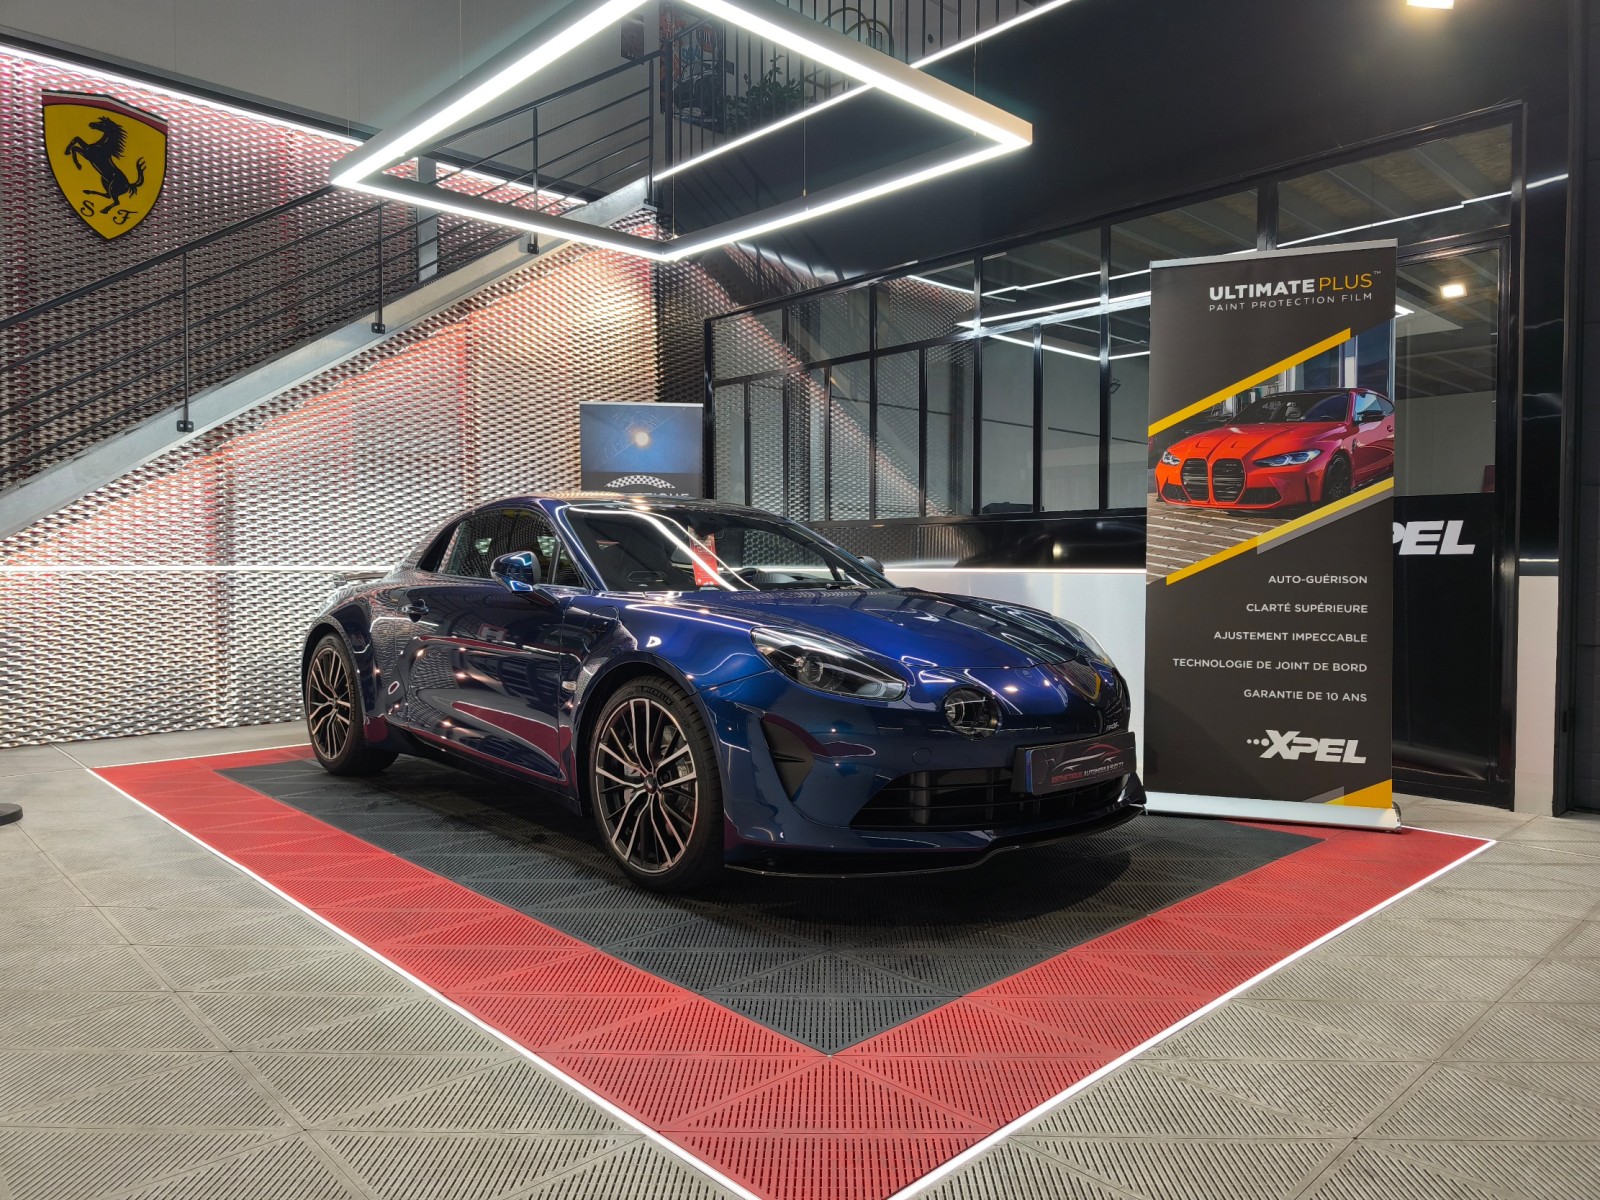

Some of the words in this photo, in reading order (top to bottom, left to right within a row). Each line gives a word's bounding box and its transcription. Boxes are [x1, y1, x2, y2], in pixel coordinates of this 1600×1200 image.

[80, 200, 95, 217] S
[112, 209, 139, 225] F
[1209, 278, 1316, 301] ULTIMATE
[1319, 273, 1373, 292] PLUS
[1209, 302, 1246, 312] PAINT
[1251, 296, 1335, 309] PROTECTION
[1342, 292, 1372, 302] FILM
[1268, 573, 1368, 585] AUTO-GUÉRISON
[1246, 601, 1291, 613] CLARTÉ
[1294, 602, 1368, 614] SUPÉRIEURE
[1213, 631, 1288, 642] AJUSTEMENT
[1292, 632, 1368, 643] IMPECCABLE
[1172, 658, 1253, 669] TECHNOLOGIE
[1256, 660, 1272, 670] DE
[1275, 660, 1309, 671] JOINT
[1313, 662, 1330, 672] DE
[1333, 662, 1368, 673] BORD
[1243, 689, 1303, 701] GARANTIE
[1307, 691, 1323, 701] DE
[1326, 691, 1339, 702] 10
[1342, 691, 1367, 703] ANS
[1259, 729, 1367, 764] XPEL
